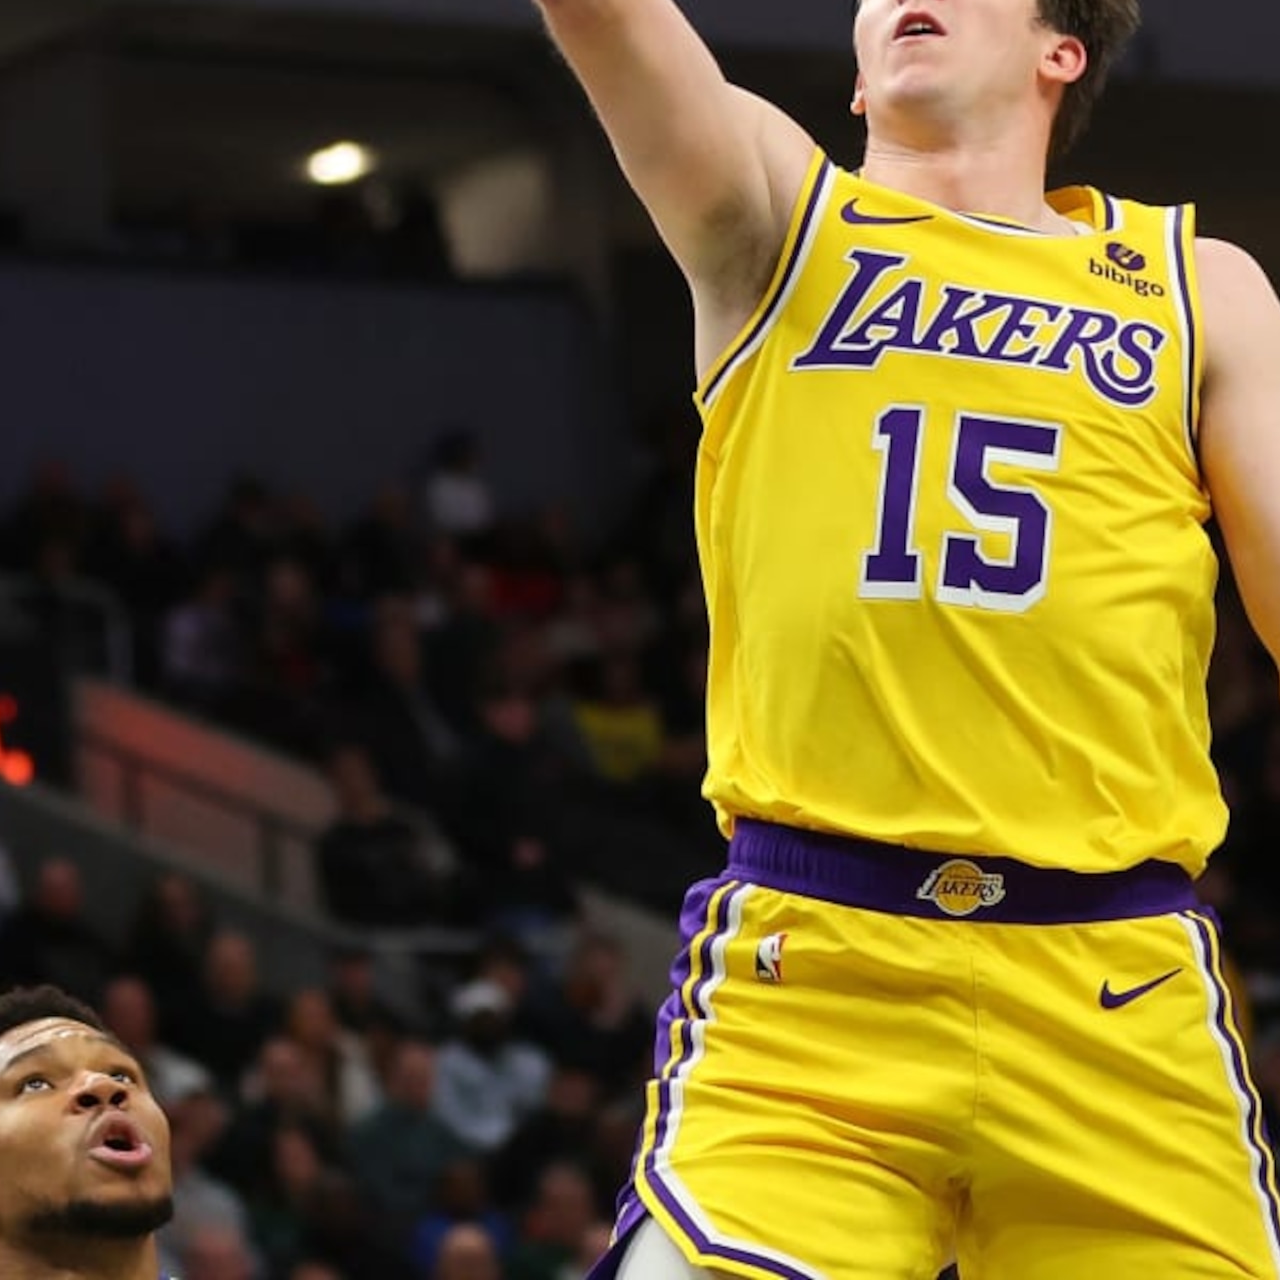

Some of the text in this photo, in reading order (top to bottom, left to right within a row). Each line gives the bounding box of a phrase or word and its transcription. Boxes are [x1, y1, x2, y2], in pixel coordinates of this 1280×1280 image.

[1089, 258, 1165, 297] bibigo
[789, 248, 1167, 407] LAKERS
[860, 405, 1062, 610] 15
[918, 870, 1005, 906] LAKERS
